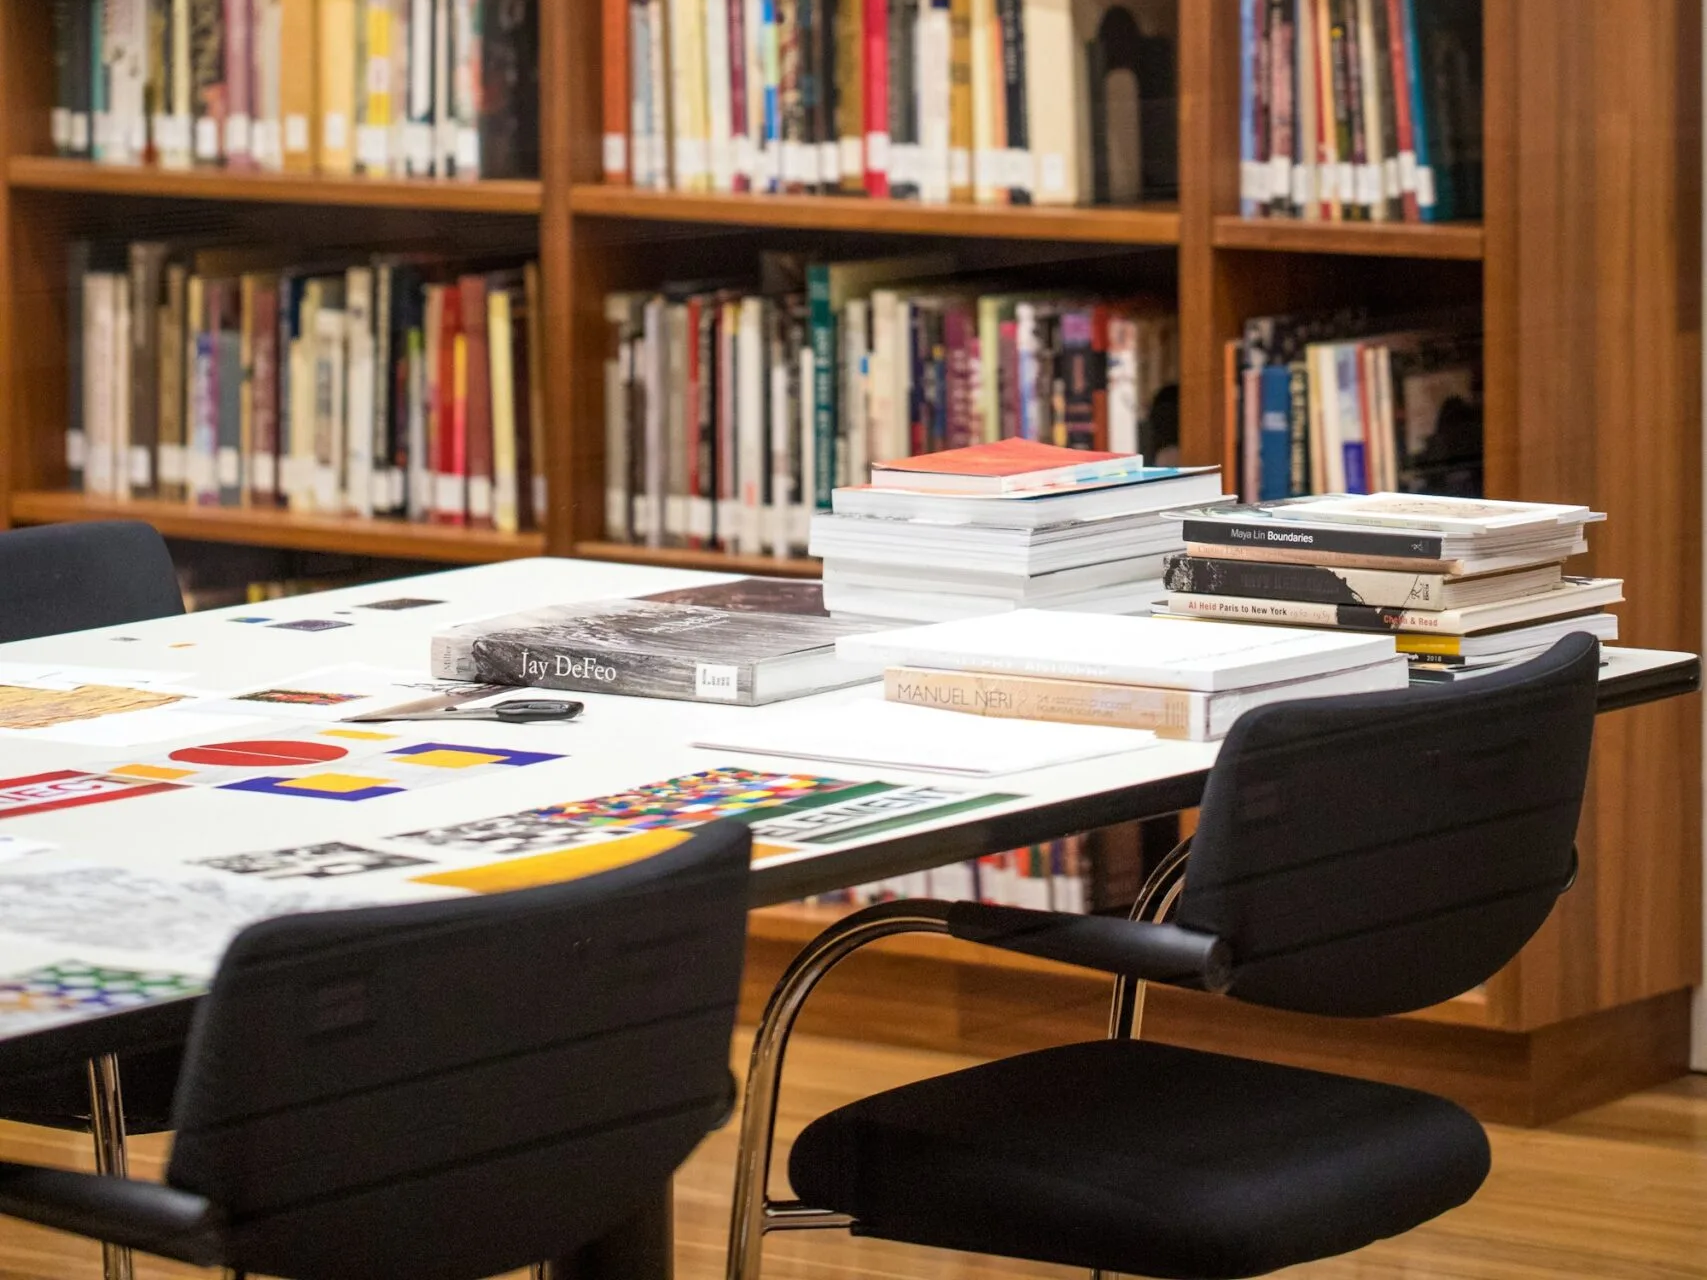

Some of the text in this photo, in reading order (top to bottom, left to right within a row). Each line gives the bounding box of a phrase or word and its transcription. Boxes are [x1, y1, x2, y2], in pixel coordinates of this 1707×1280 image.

[1231, 528, 1314, 543] Maya Lin Boundaries
[1188, 601, 1197, 609] Al
[1219, 603, 1239, 612] Paris
[1241, 605, 1248, 613] to
[1251, 606, 1267, 614] New
[1270, 607, 1287, 615] York
[1418, 617, 1438, 626] Read
[518, 648, 617, 681] Jay DeFeo
[897, 683, 970, 707] MANUEL
[975, 688, 1013, 710] NERI
